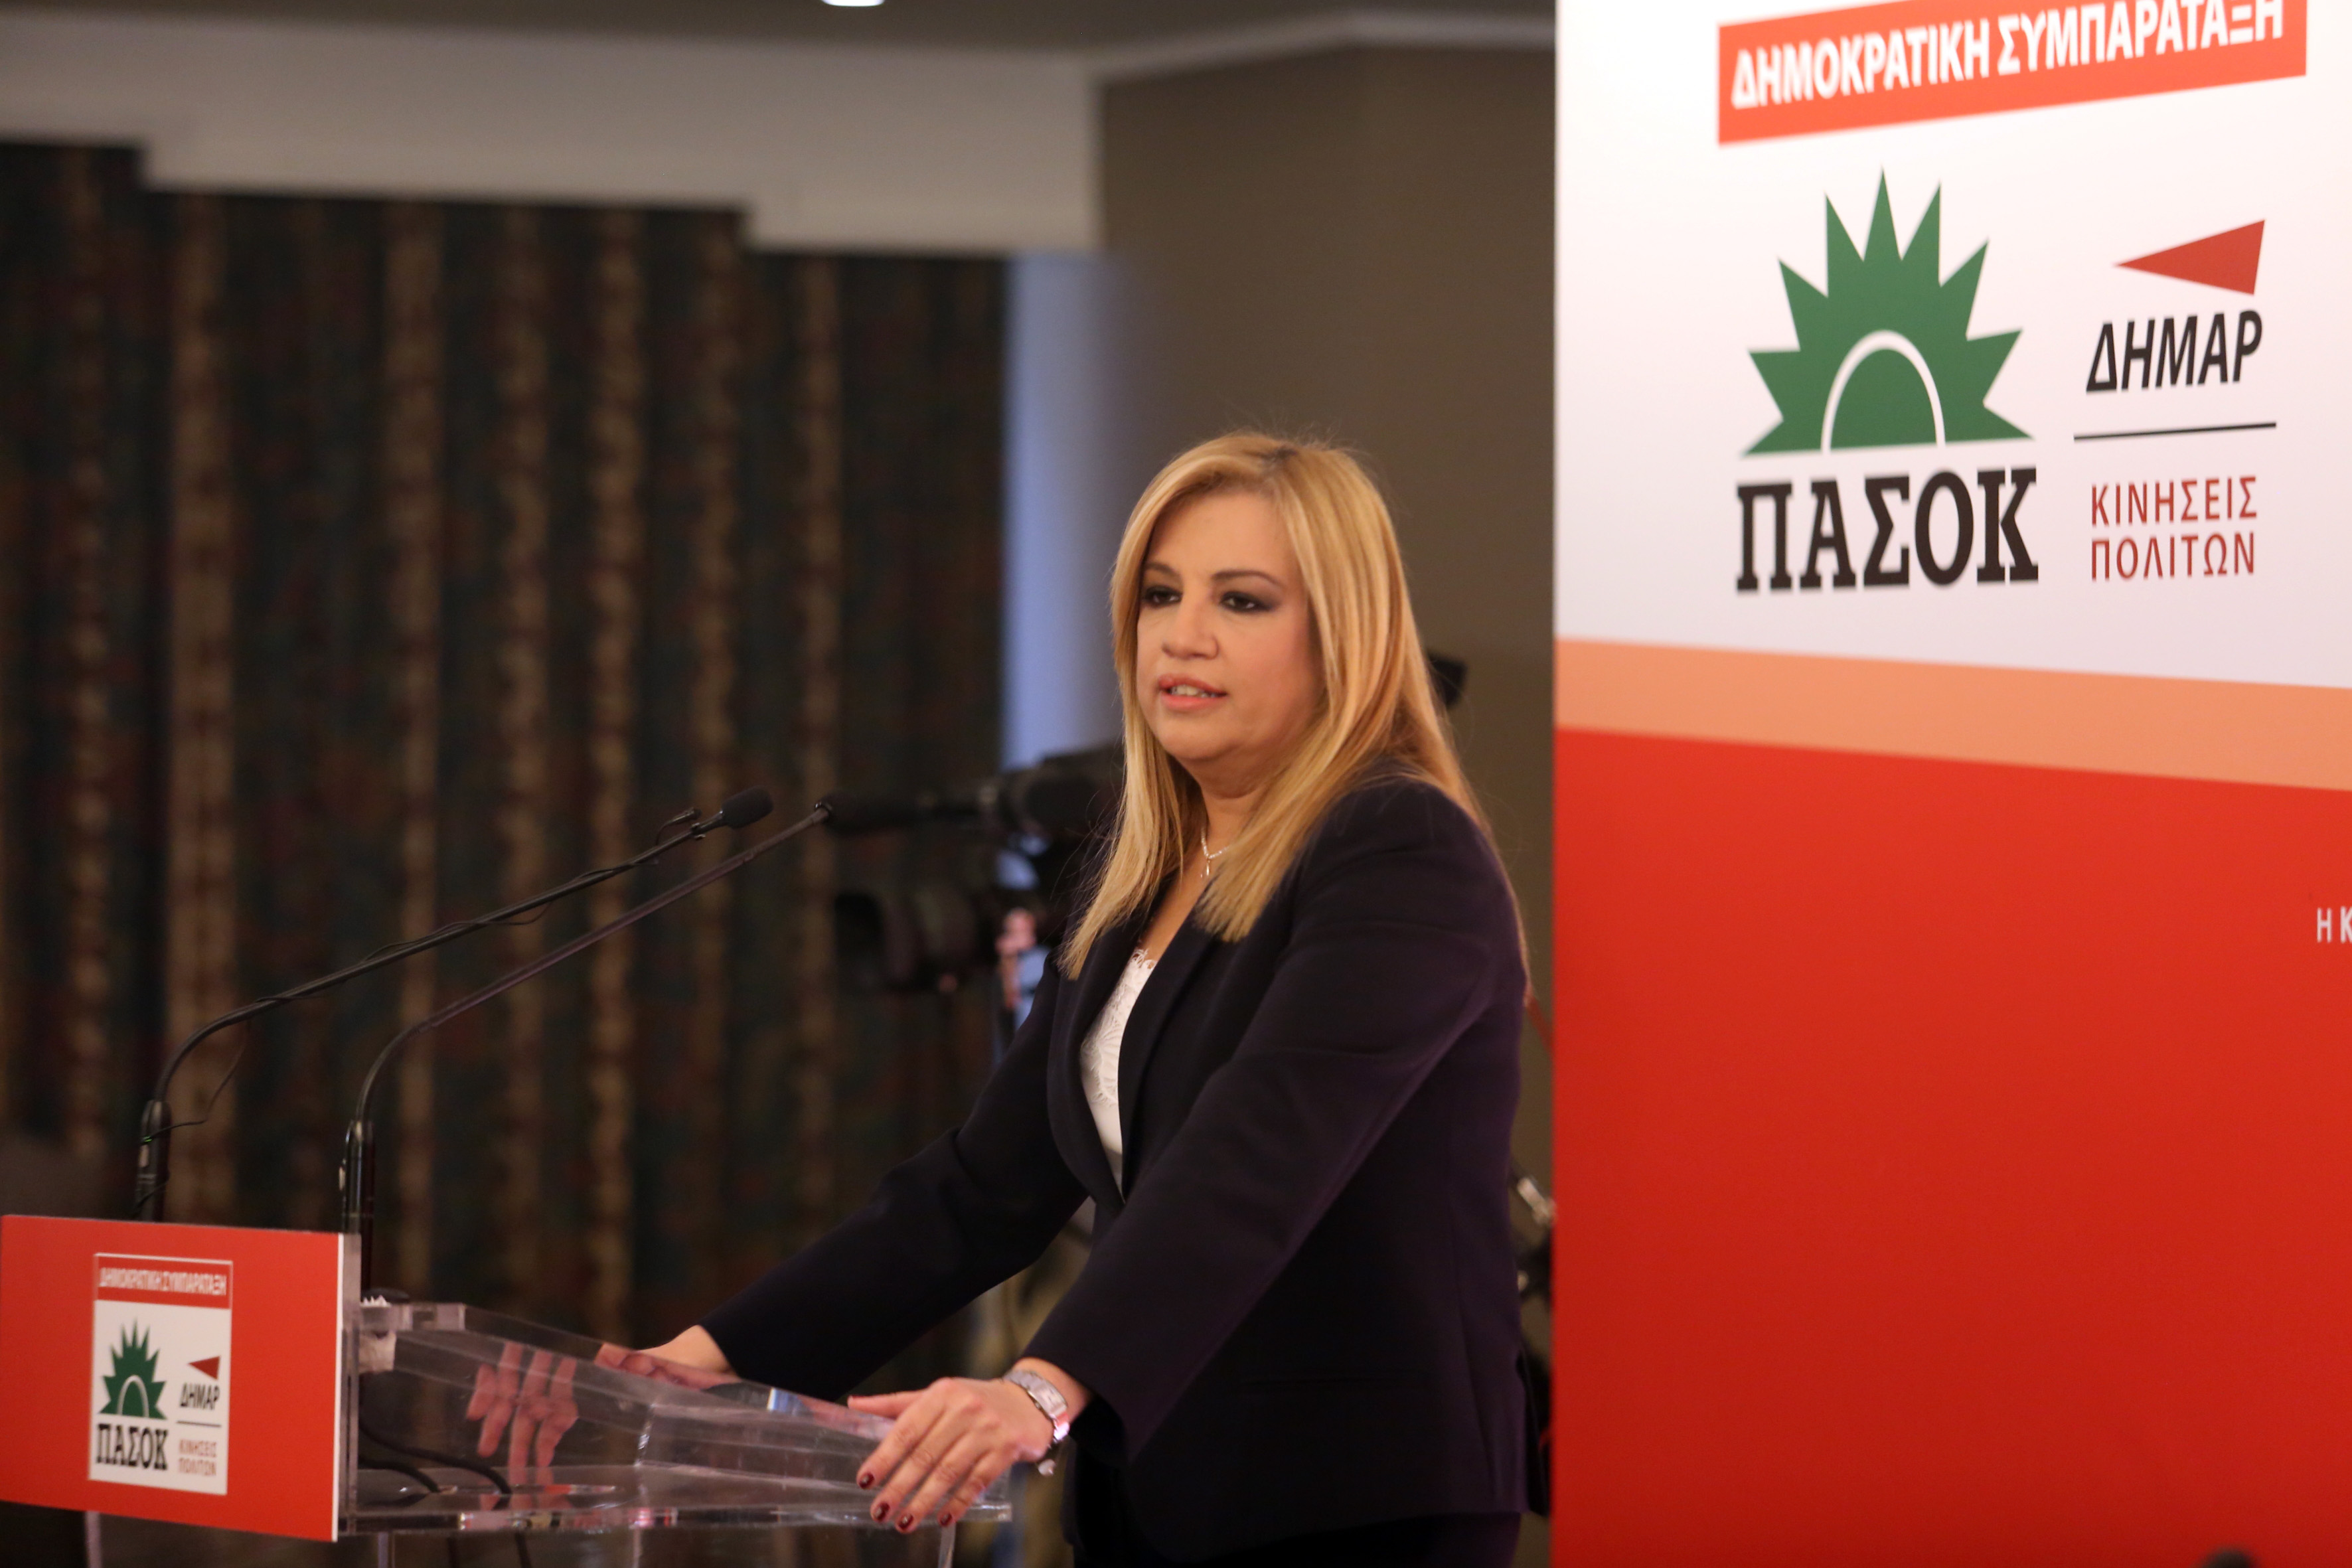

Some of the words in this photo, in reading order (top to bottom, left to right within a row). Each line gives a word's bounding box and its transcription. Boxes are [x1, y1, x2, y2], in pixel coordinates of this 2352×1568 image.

[1731, 19, 1990, 110] ΔΗΜΟΚΡΑΤΙΚΗ
[1998, 0, 2284, 74] ΣΥΜΠΑΡΑΤΑΞΗ
[2086, 309, 2264, 393] ΔΗΜΑΡ
[2090, 475, 2258, 526] ΚΙΝΗΣΕΙΣ
[1737, 466, 2039, 591] ΠΑΣΟΚ
[2090, 532, 2255, 581] ΠΟΛΙΤΩΝ
[2317, 907, 2331, 943] Η
[179, 1383, 220, 1410] ΔΗΜΑΡ
[96, 1423, 169, 1470] ΠΑΣΟΚ
